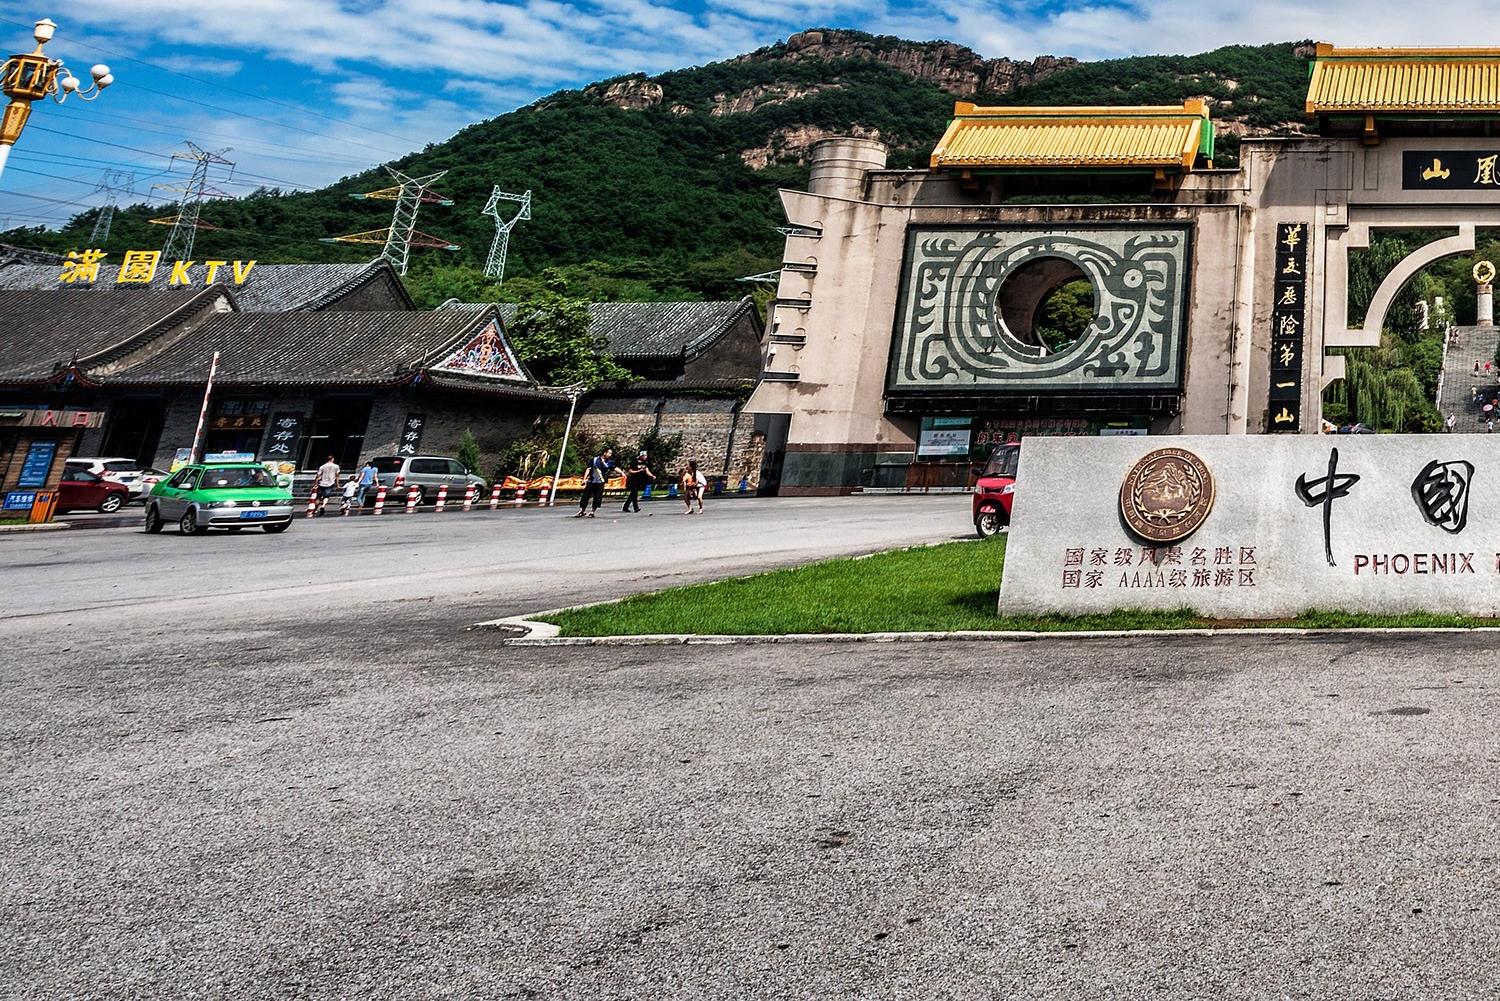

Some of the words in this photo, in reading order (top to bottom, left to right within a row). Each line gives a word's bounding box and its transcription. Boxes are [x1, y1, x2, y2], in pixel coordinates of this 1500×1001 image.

[169, 260, 257, 286] KTV
[40, 410, 90, 427] 入口
[269, 418, 298, 454] 寄存处
[400, 419, 422, 454] 寄存处
[1063, 546, 1257, 568] 国家级风景名胜区
[1353, 552, 1475, 576] PHOENIX
[1062, 569, 1104, 589] 国家
